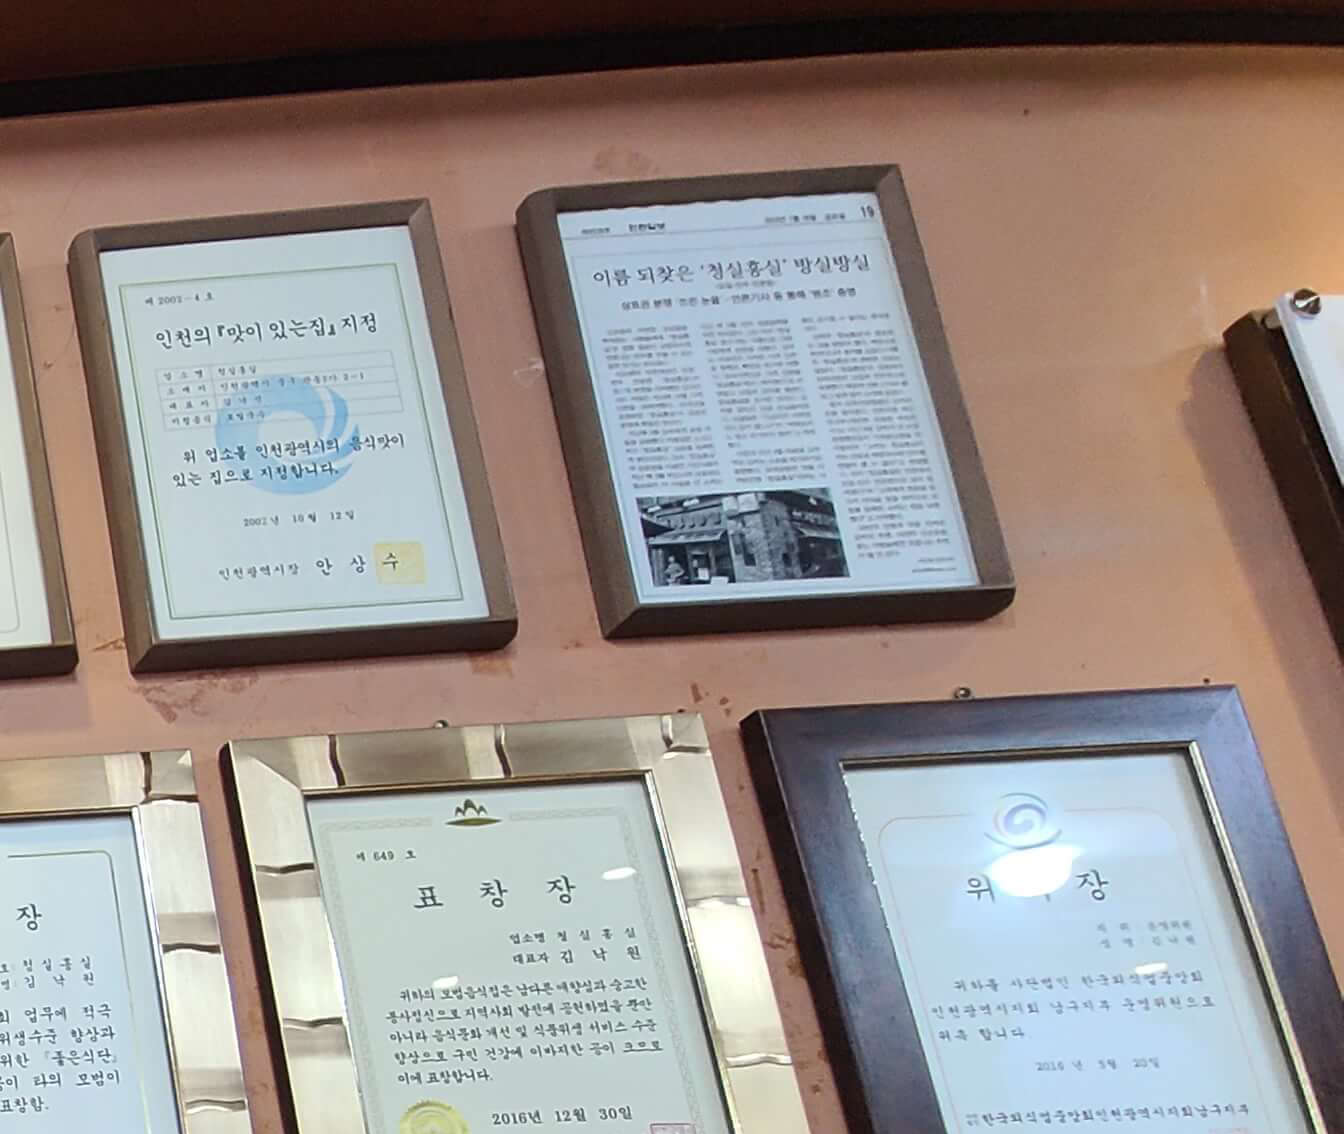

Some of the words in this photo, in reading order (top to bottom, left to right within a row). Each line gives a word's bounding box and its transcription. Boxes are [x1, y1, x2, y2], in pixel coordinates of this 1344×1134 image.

[860, 205, 875, 218] 19
[155, 325, 211, 350] 인천의
[340, 311, 377, 334] 지정
[491, 1109, 543, 1125] 2016년
[554, 1107, 587, 1122] 12월
[598, 1105, 633, 1120] 30일
